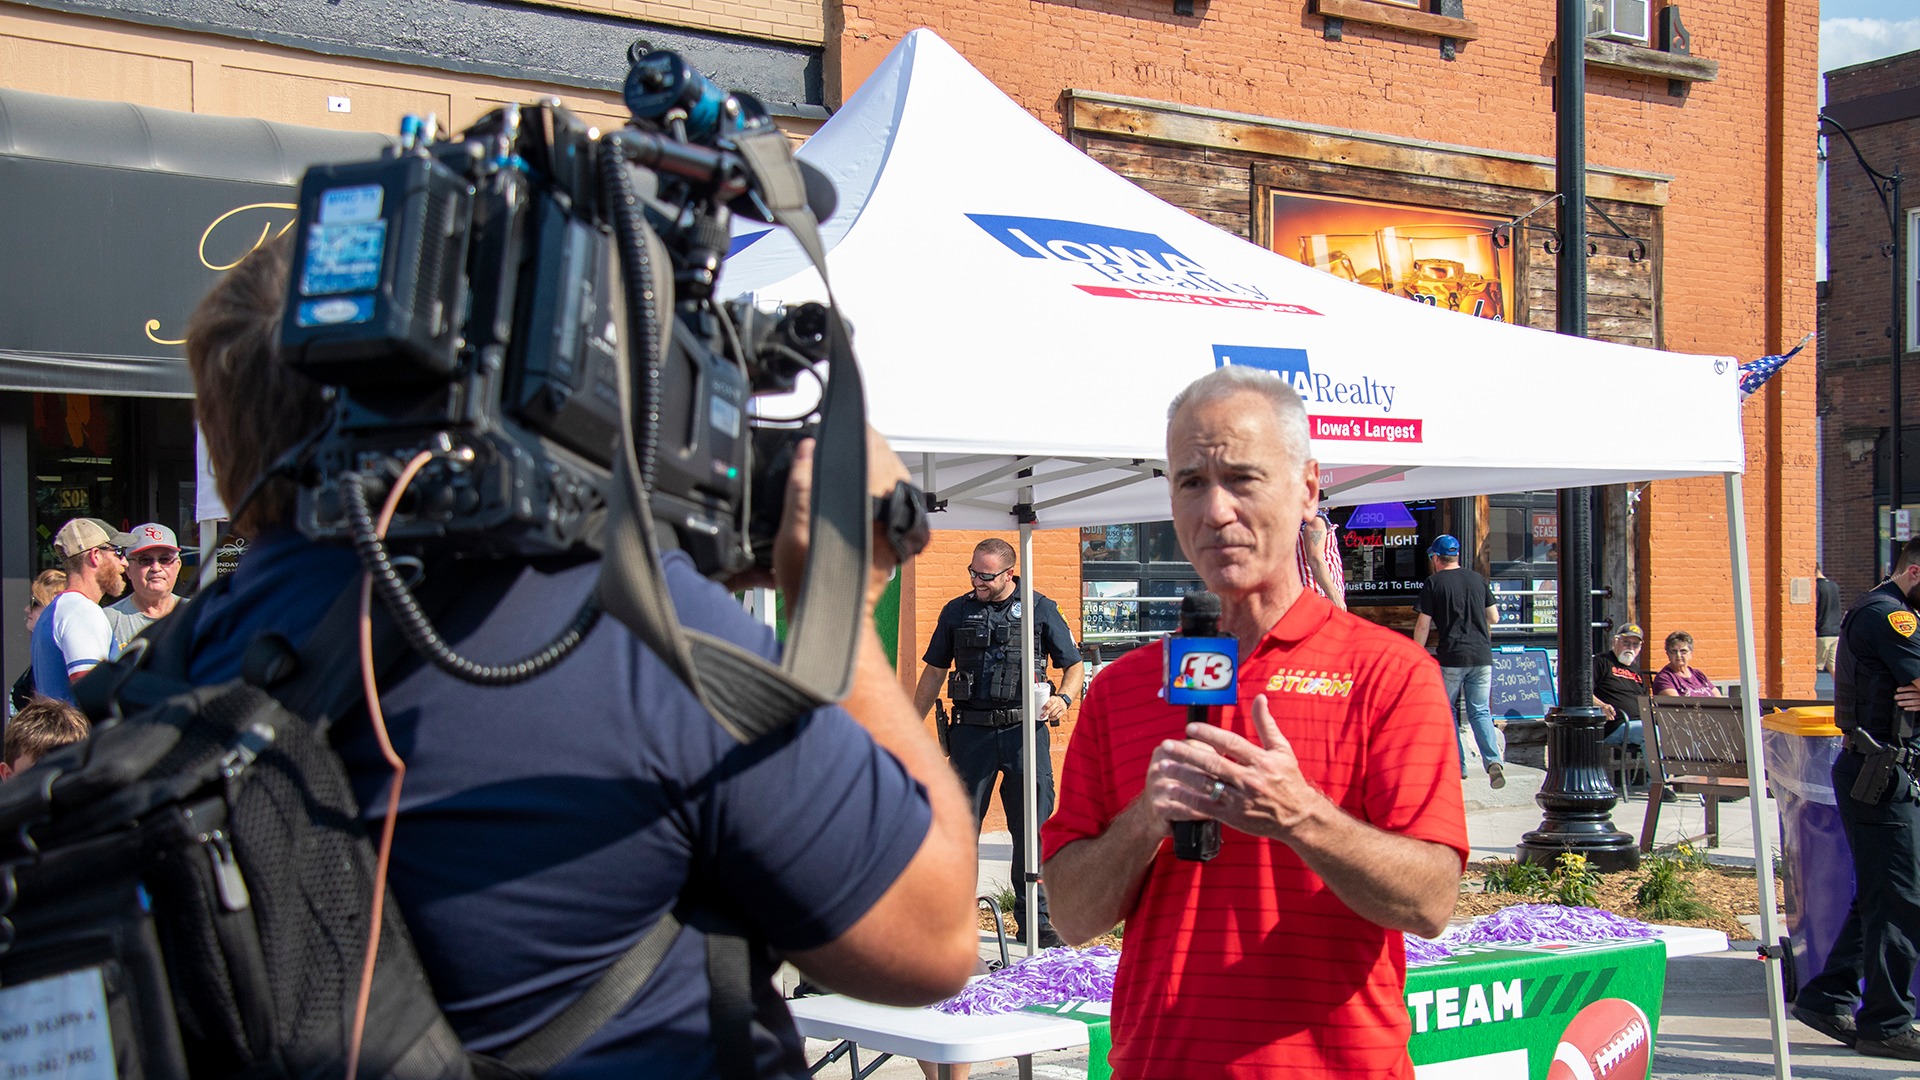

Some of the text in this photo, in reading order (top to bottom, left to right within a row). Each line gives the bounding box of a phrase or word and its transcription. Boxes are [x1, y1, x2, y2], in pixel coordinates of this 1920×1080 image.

[1007, 227, 1206, 273] IOWA
[1313, 373, 1397, 413] Realty
[1316, 418, 1416, 442] Iowa's Largest
[145, 526, 163, 541] SC
[1384, 534, 1419, 547] LIGHT
[1364, 581, 1377, 590] Be
[1378, 581, 1388, 590] 21
[1391, 580, 1402, 590] To
[1404, 580, 1425, 590] Ente
[1182, 654, 1233, 690] 13
[1497, 673, 1516, 687] 4.00
[1266, 675, 1354, 697] STORM
[1501, 691, 1517, 704] 5.00
[1407, 978, 1524, 1033] TEAM
